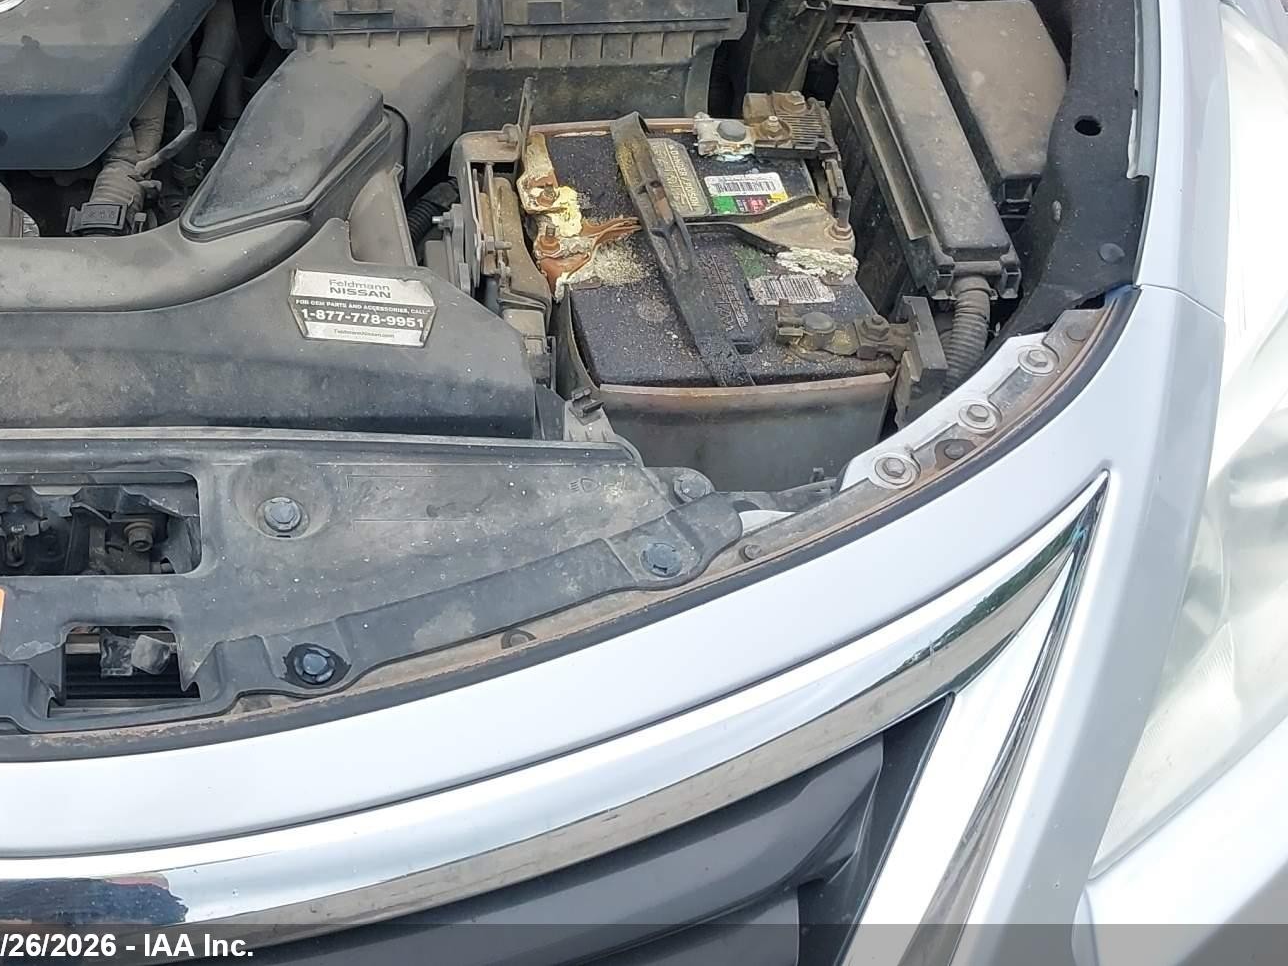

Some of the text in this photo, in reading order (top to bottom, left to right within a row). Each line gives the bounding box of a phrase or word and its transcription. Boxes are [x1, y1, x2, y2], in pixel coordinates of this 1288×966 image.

[329, 279, 390, 291] Feldmann
[330, 287, 392, 299] NISSAN
[326, 301, 346, 309] PARTS
[300, 308, 425, 328] 1-877-778-9951
